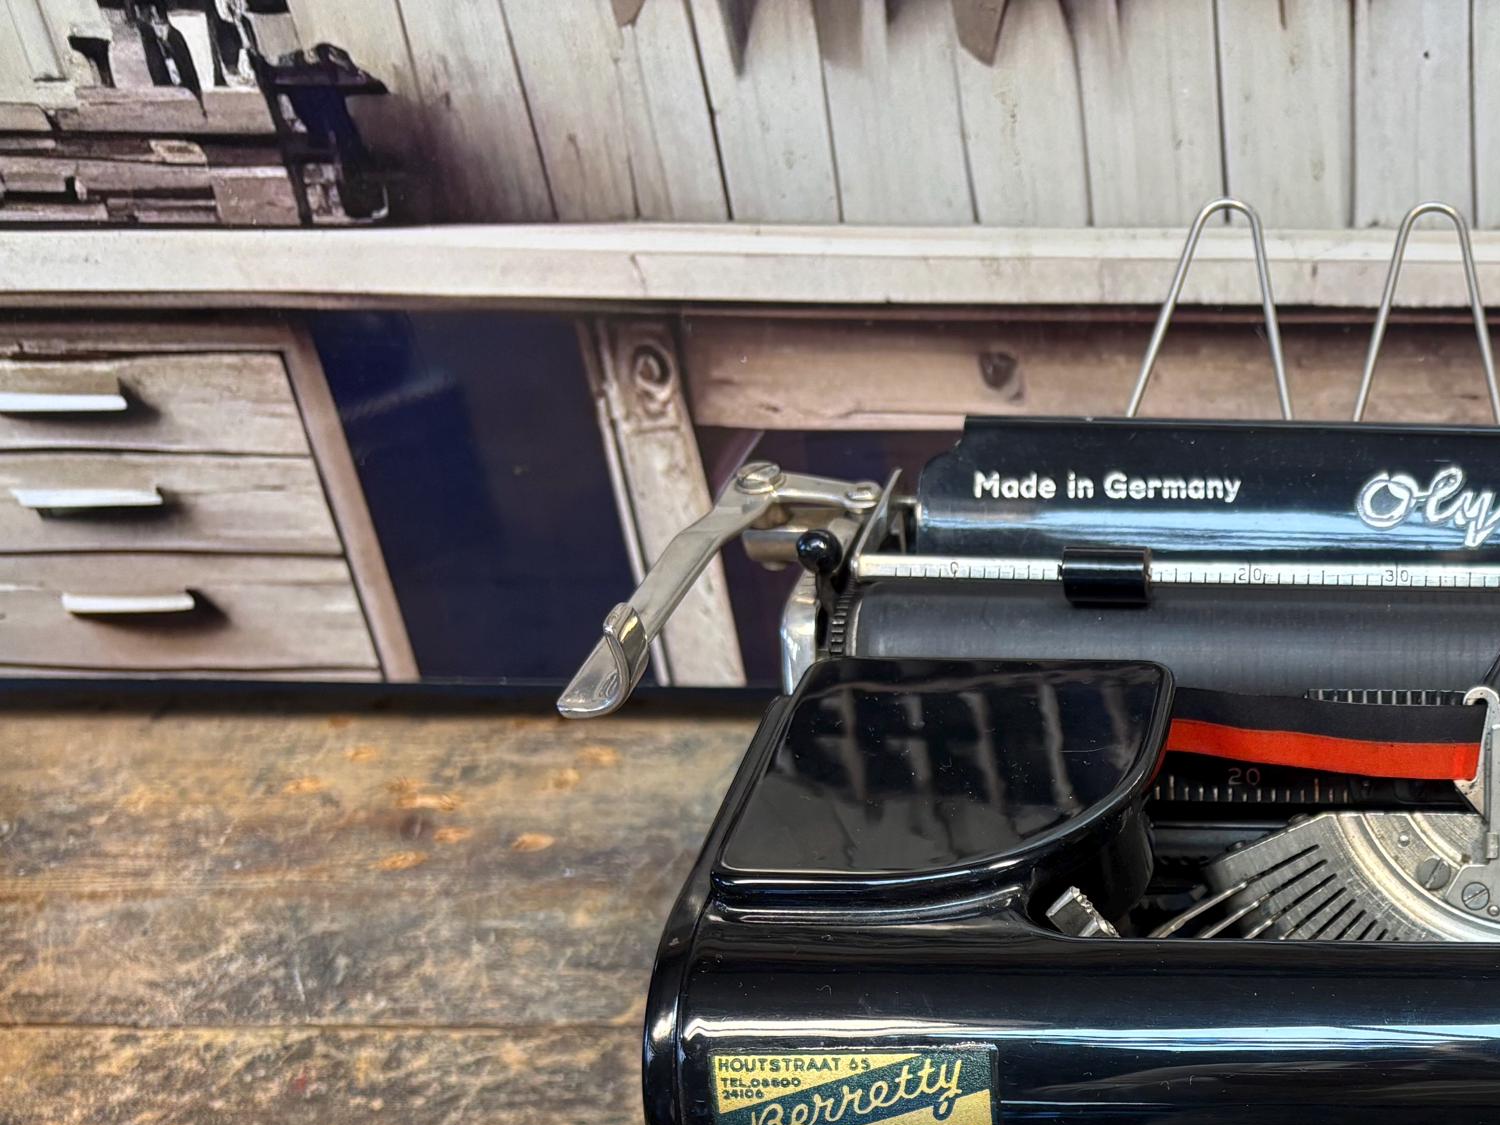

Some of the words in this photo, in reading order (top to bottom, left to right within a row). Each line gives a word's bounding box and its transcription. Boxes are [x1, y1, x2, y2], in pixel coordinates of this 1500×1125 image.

[974, 472, 1057, 499] Made
[1067, 473, 1094, 499] in
[1103, 472, 1242, 503] Germany
[1237, 566, 1263, 583] 20
[1383, 568, 1410, 583] 30
[1228, 768, 1261, 786] 20
[718, 1058, 841, 1072] HOUTSTRAAT
